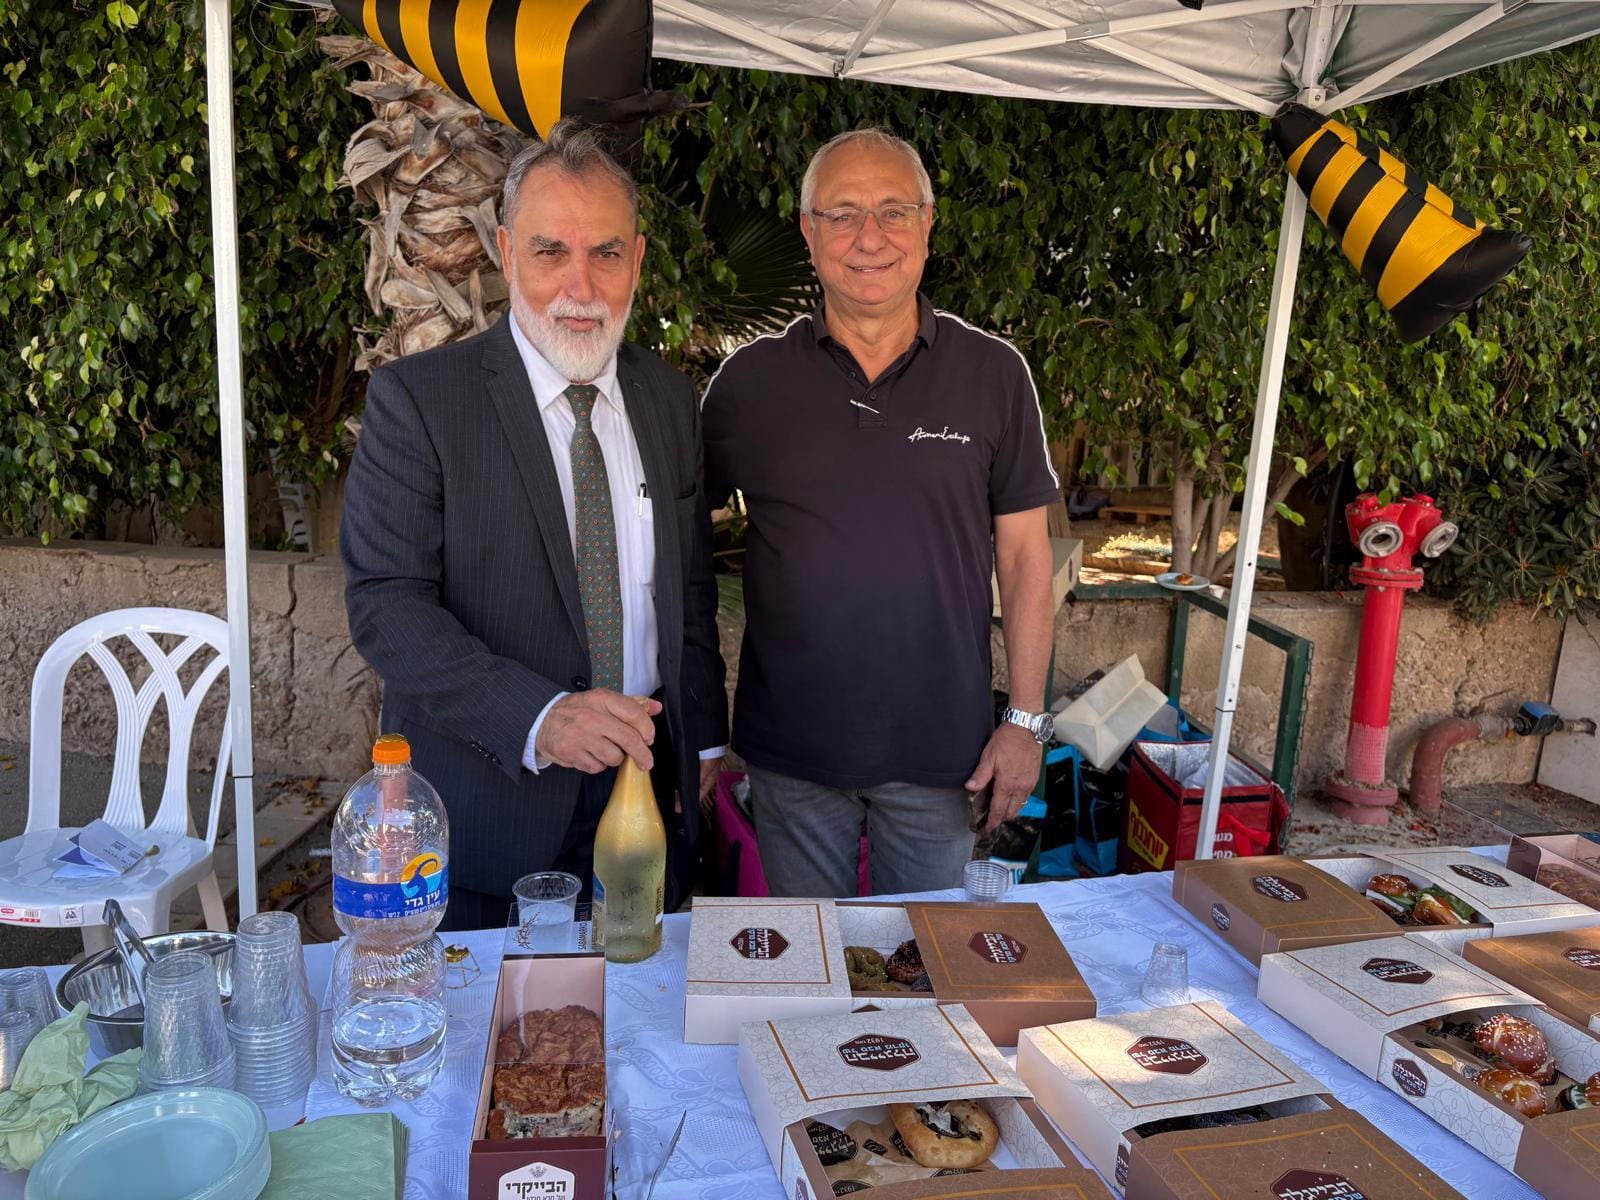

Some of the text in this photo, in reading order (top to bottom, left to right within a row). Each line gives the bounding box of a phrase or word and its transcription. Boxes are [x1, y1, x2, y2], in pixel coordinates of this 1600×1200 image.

[405, 889, 440, 907] עין גדי
[845, 1048, 915, 1061] הבייגלה
[1137, 1050, 1201, 1066] הבייגלה
[505, 1181, 567, 1199] הבייקרי
